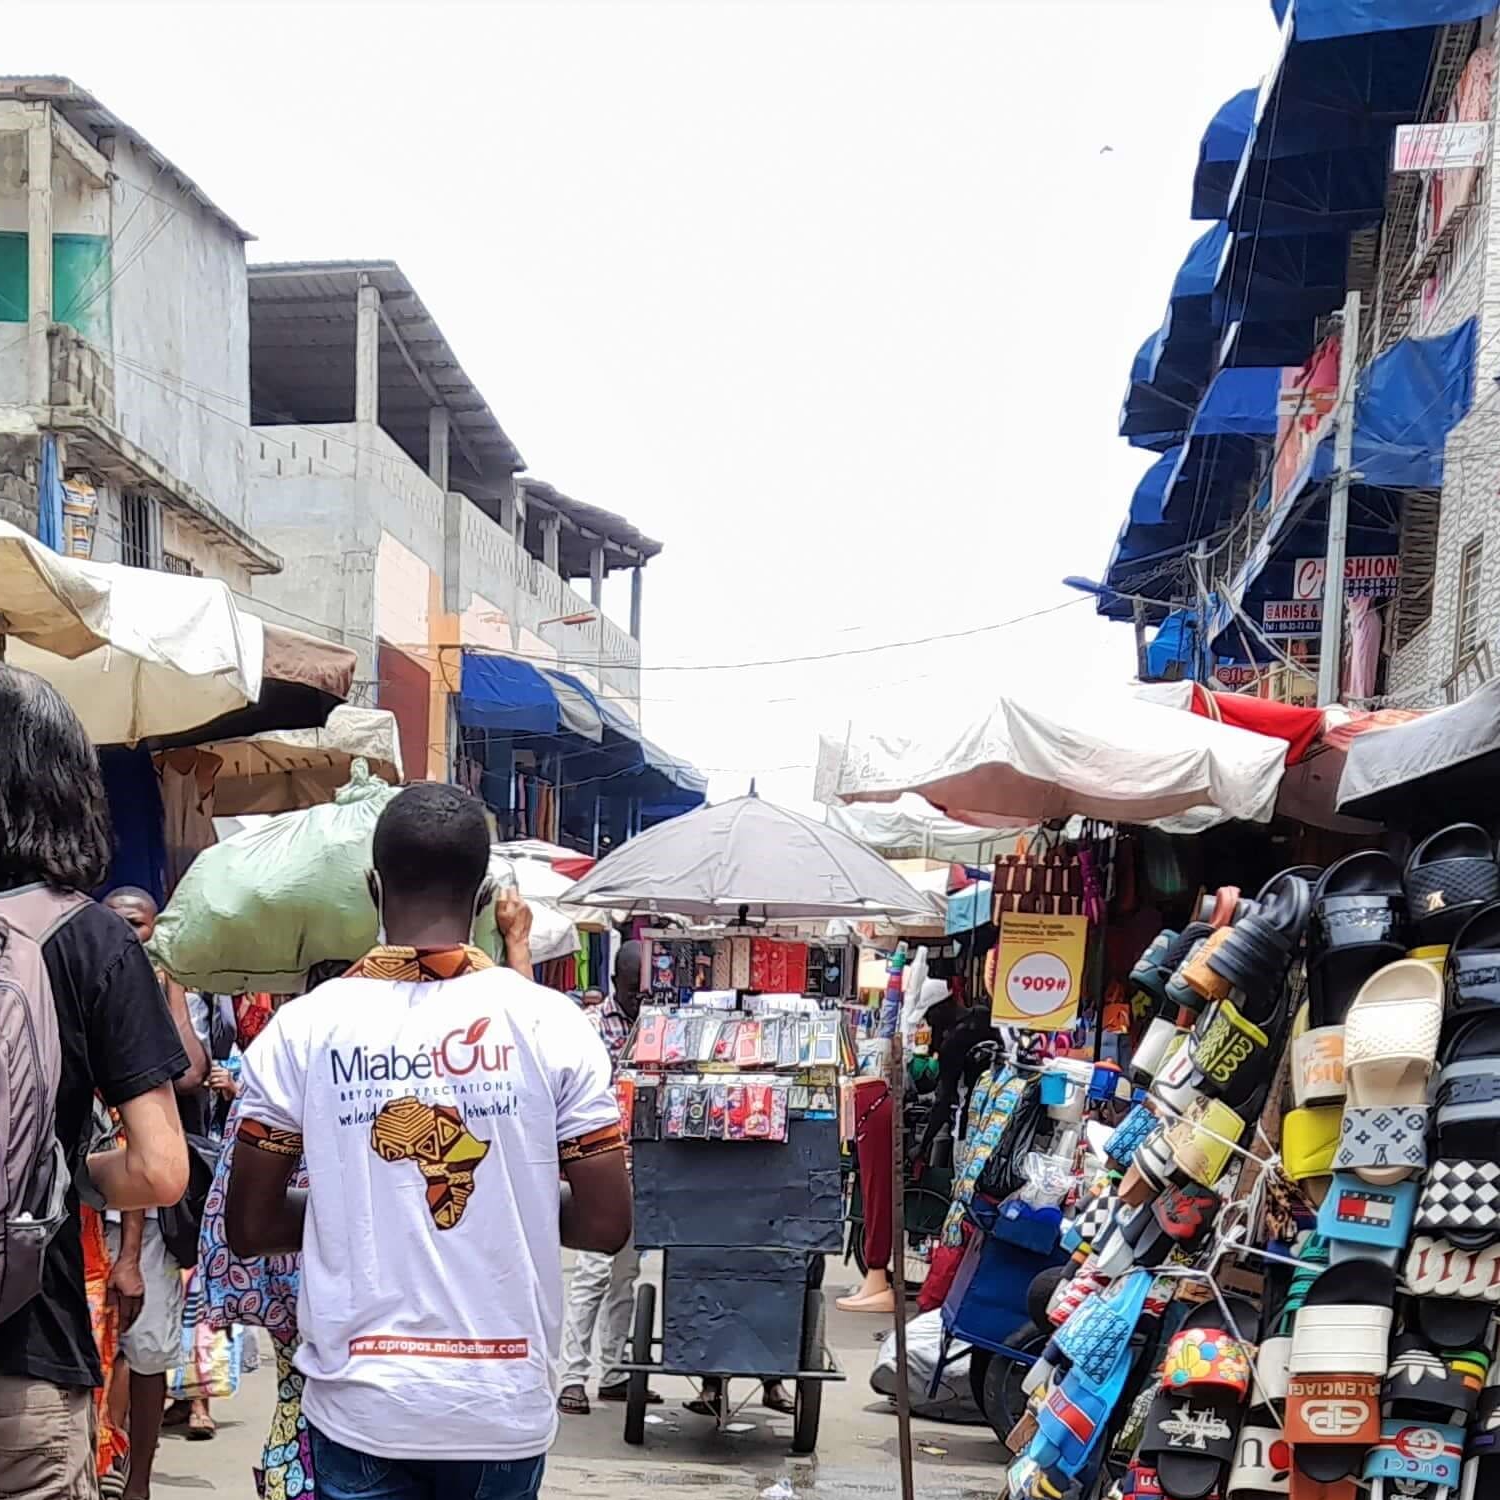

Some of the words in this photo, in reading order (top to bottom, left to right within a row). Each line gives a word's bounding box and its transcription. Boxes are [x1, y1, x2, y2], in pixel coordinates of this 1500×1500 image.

[1344, 557, 1397, 577] SHION
[340, 1087, 394, 1102] BEYOND
[404, 1080, 513, 1098] EXPECTATIONS
